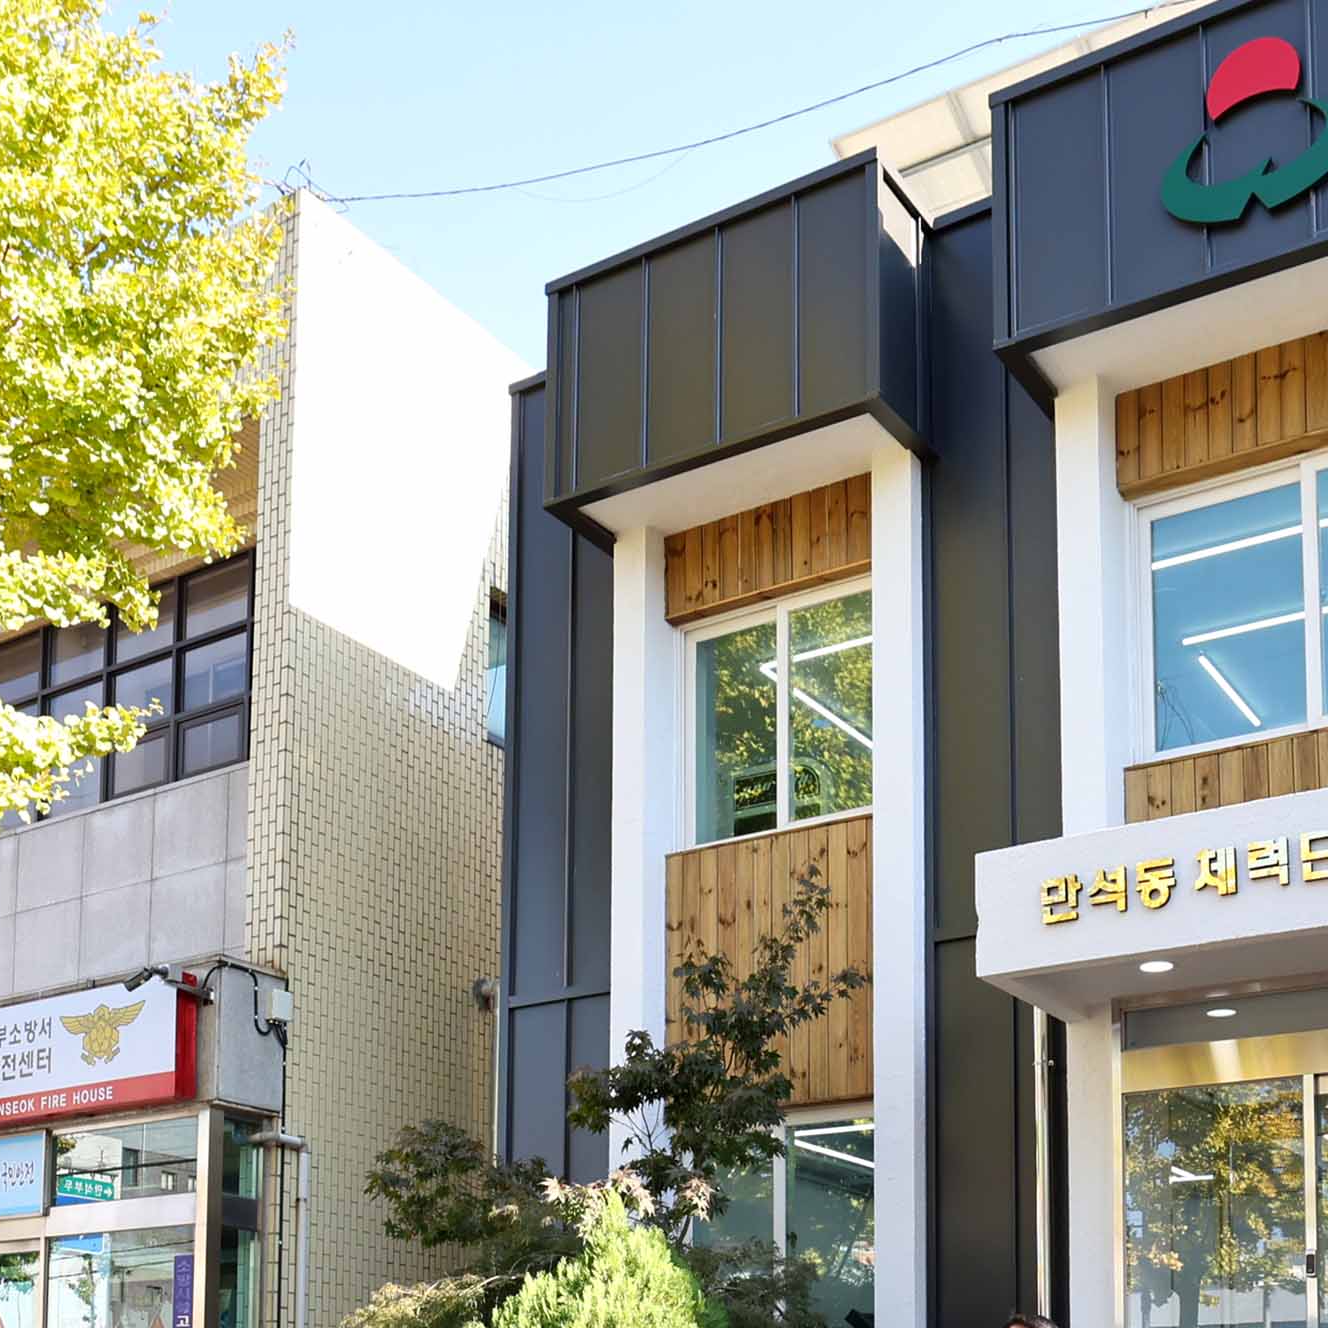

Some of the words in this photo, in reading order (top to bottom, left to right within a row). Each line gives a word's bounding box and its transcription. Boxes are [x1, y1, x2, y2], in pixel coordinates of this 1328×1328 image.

[1040, 856, 1176, 924] 만석동
[40, 1093, 67, 1111] FIRE
[72, 1086, 113, 1105] HOUSE
